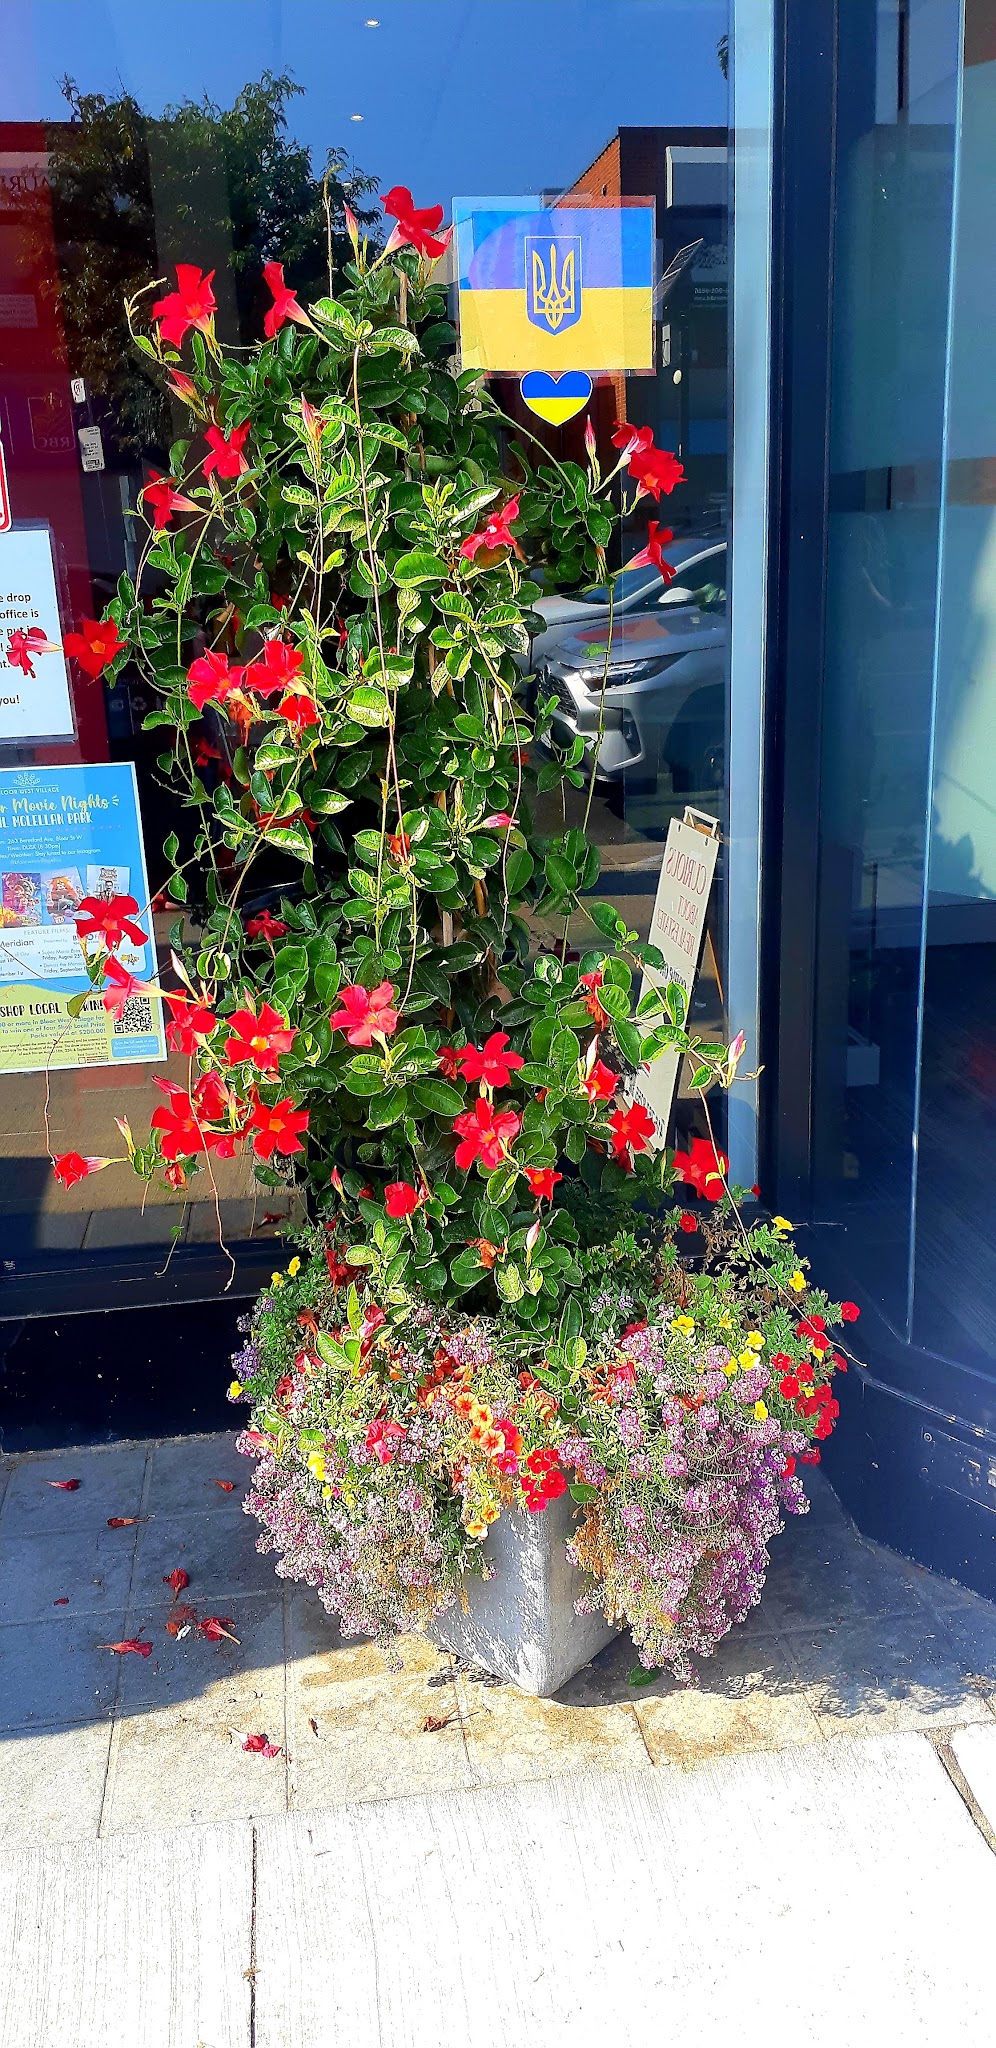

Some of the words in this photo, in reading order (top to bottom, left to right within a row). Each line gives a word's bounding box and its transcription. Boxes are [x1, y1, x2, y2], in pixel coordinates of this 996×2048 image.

[7, 592, 31, 604] drop
[0, 609, 28, 619] office
[31, 608, 39, 618] is
[12, 797, 57, 814] Movie
[61, 793, 110, 813] Nights
[67, 812, 93, 825] PARK
[0, 1005, 25, 1018] SHOP
[29, 1002, 62, 1015] LOCAL
